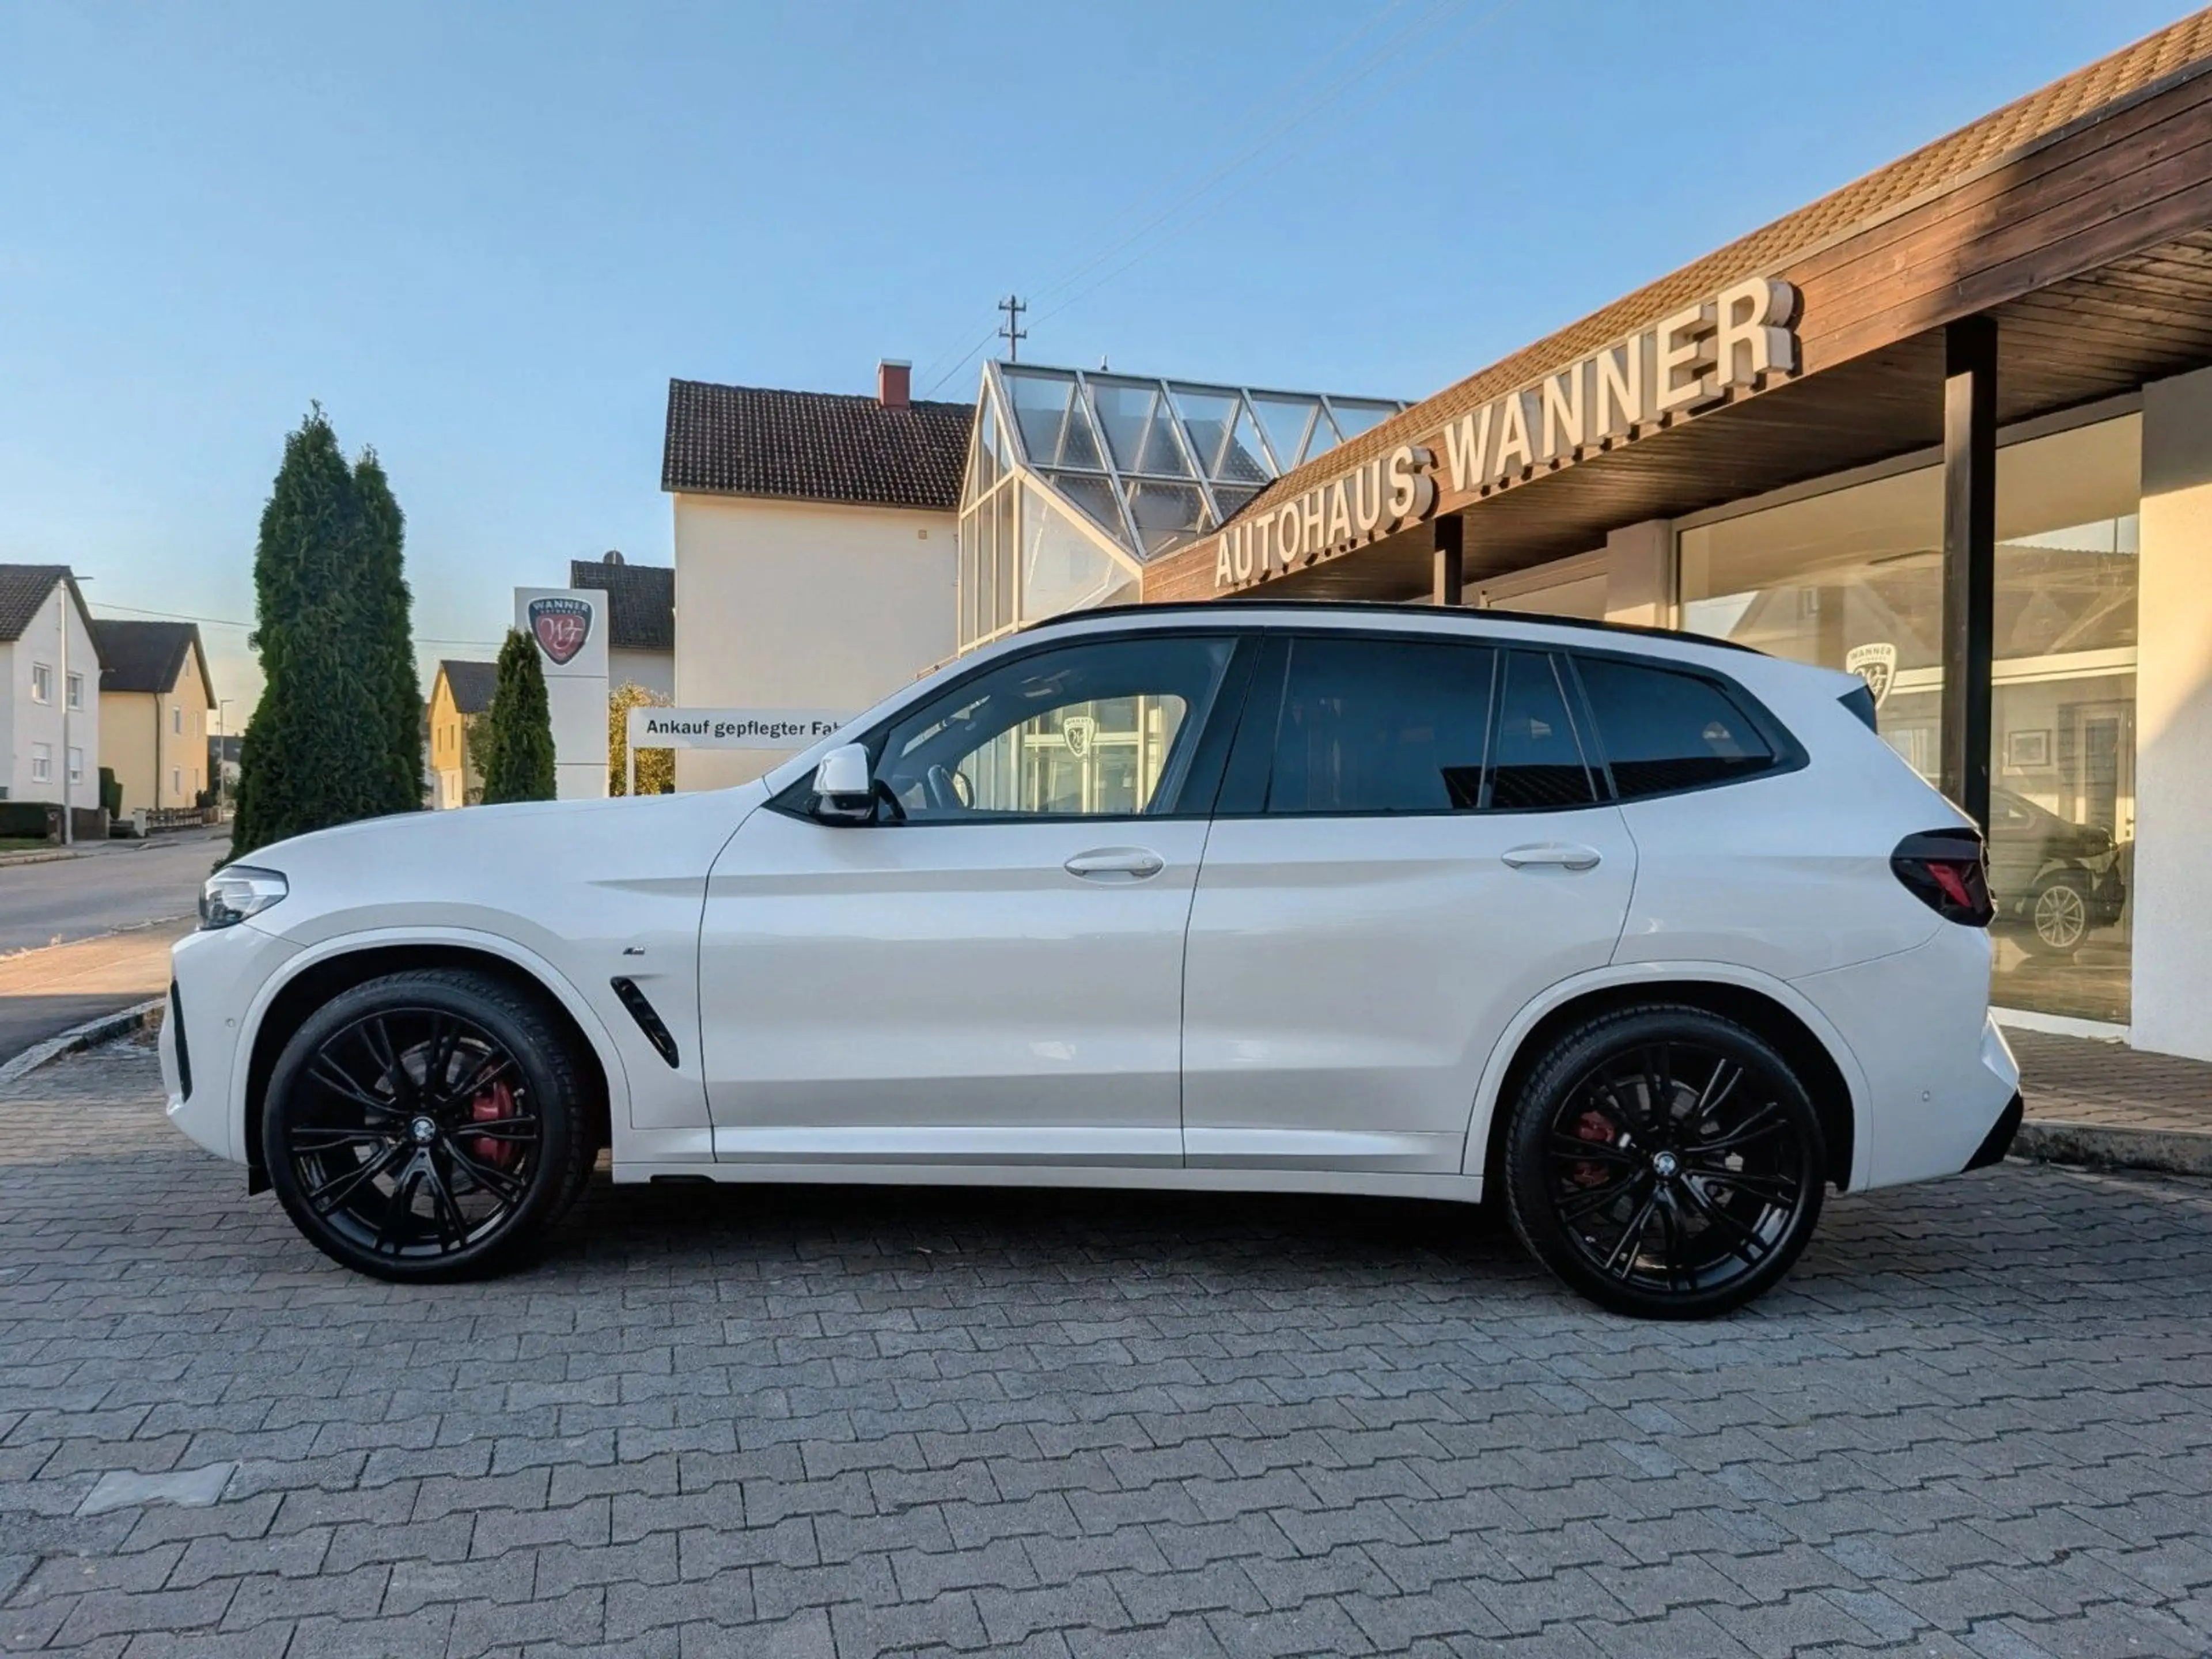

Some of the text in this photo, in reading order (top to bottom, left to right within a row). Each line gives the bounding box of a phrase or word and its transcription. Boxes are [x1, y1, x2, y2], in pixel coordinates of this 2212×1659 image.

[1214, 276, 1795, 590] AUTOHAUS WANNER
[646, 719, 710, 734] Ankauf
[714, 720, 806, 738] gepflegter
